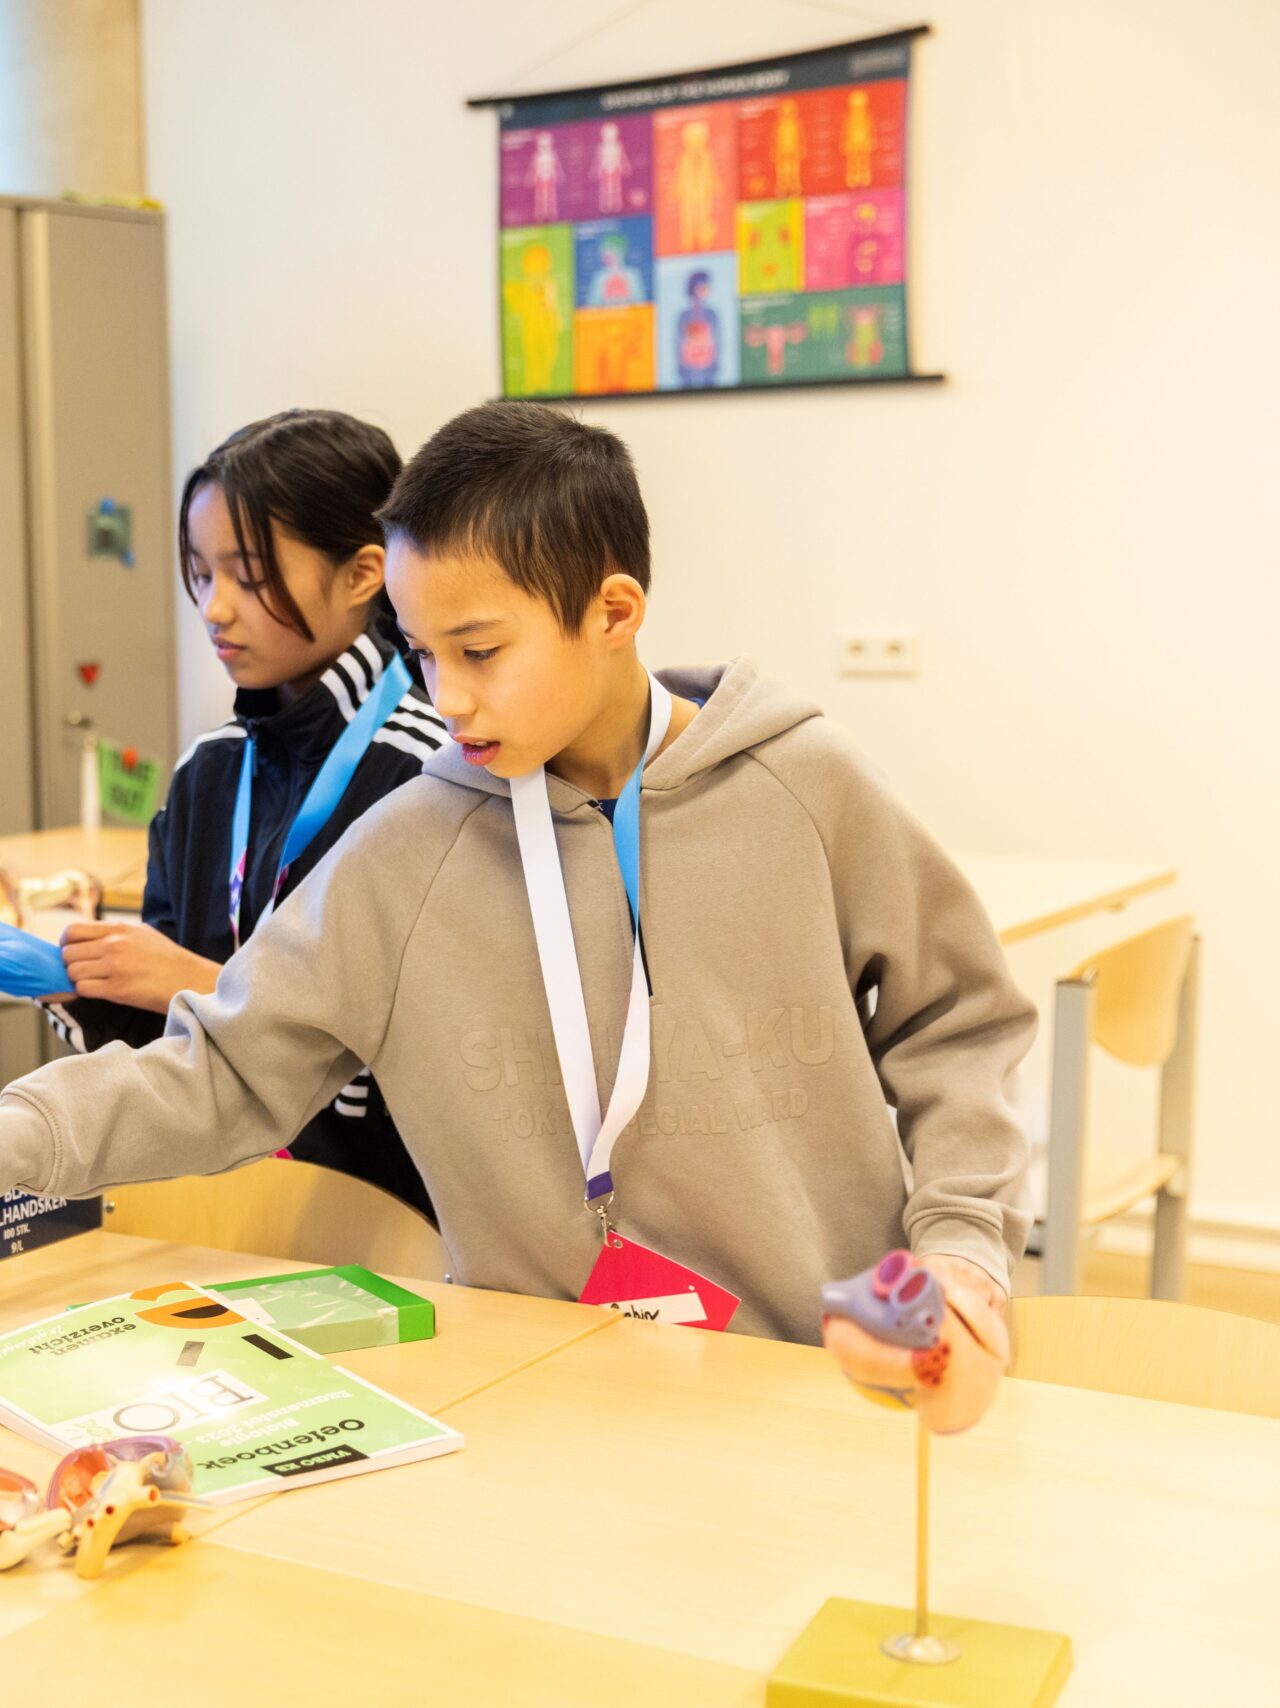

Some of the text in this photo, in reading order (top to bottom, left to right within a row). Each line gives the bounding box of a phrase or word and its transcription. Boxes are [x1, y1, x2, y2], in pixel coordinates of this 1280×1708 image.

[3, 1227, 15, 1240] 100
[28, 1316, 126, 1355] overzicht
[51, 1323, 137, 1356] examen
[112, 1375, 254, 1432] BIO
[243, 1389, 353, 1428] Examenstof
[197, 1419, 366, 1472] Oefenboek
[218, 1418, 301, 1447] Biologie
[303, 1450, 352, 1467] VMBO
